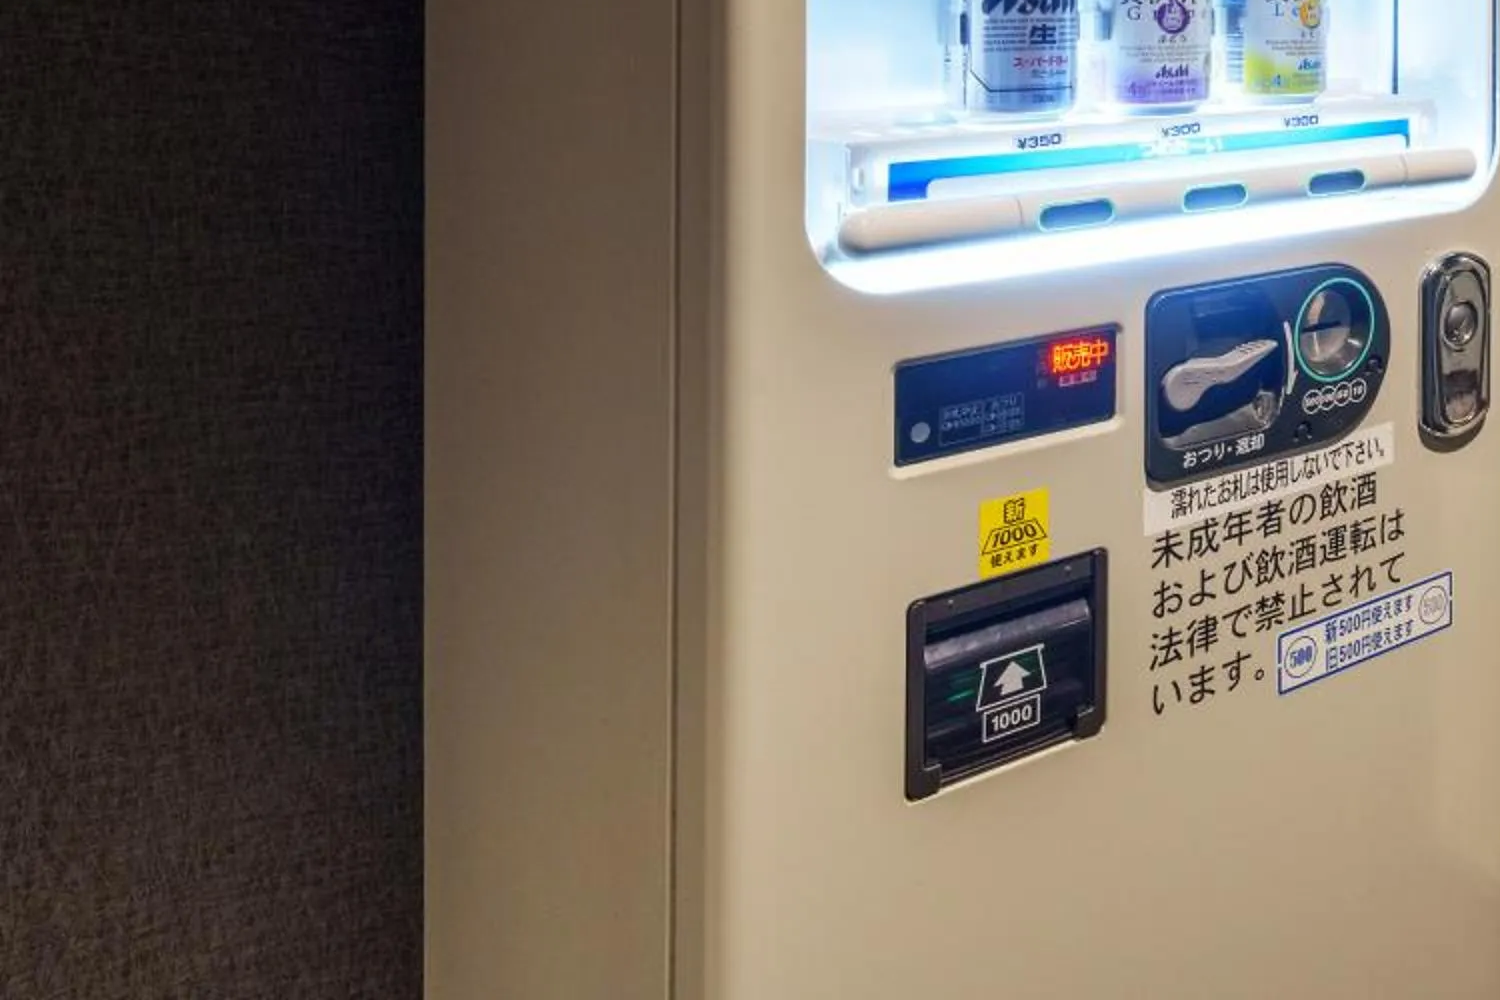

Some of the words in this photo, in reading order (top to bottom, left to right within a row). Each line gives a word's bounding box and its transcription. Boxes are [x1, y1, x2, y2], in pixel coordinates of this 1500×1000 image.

[1029, 23, 1057, 45] 生
[1017, 132, 1062, 150] ¥350
[1162, 122, 1201, 138] ¥300
[1053, 339, 1109, 373] 販売中
[991, 523, 1037, 548] 1000
[1151, 471, 1378, 570] 未成年者の飲酒
[991, 543, 1038, 569] 使えます
[1152, 508, 1406, 619] および飲酒運転は
[1149, 551, 1406, 671] 法律で禁止されて
[1324, 594, 1414, 644] 新500円使えます
[1289, 645, 1313, 669] 500
[1325, 618, 1414, 672] 旧500円使えます
[1152, 650, 1266, 716] います。
[992, 704, 1033, 731] 1000
